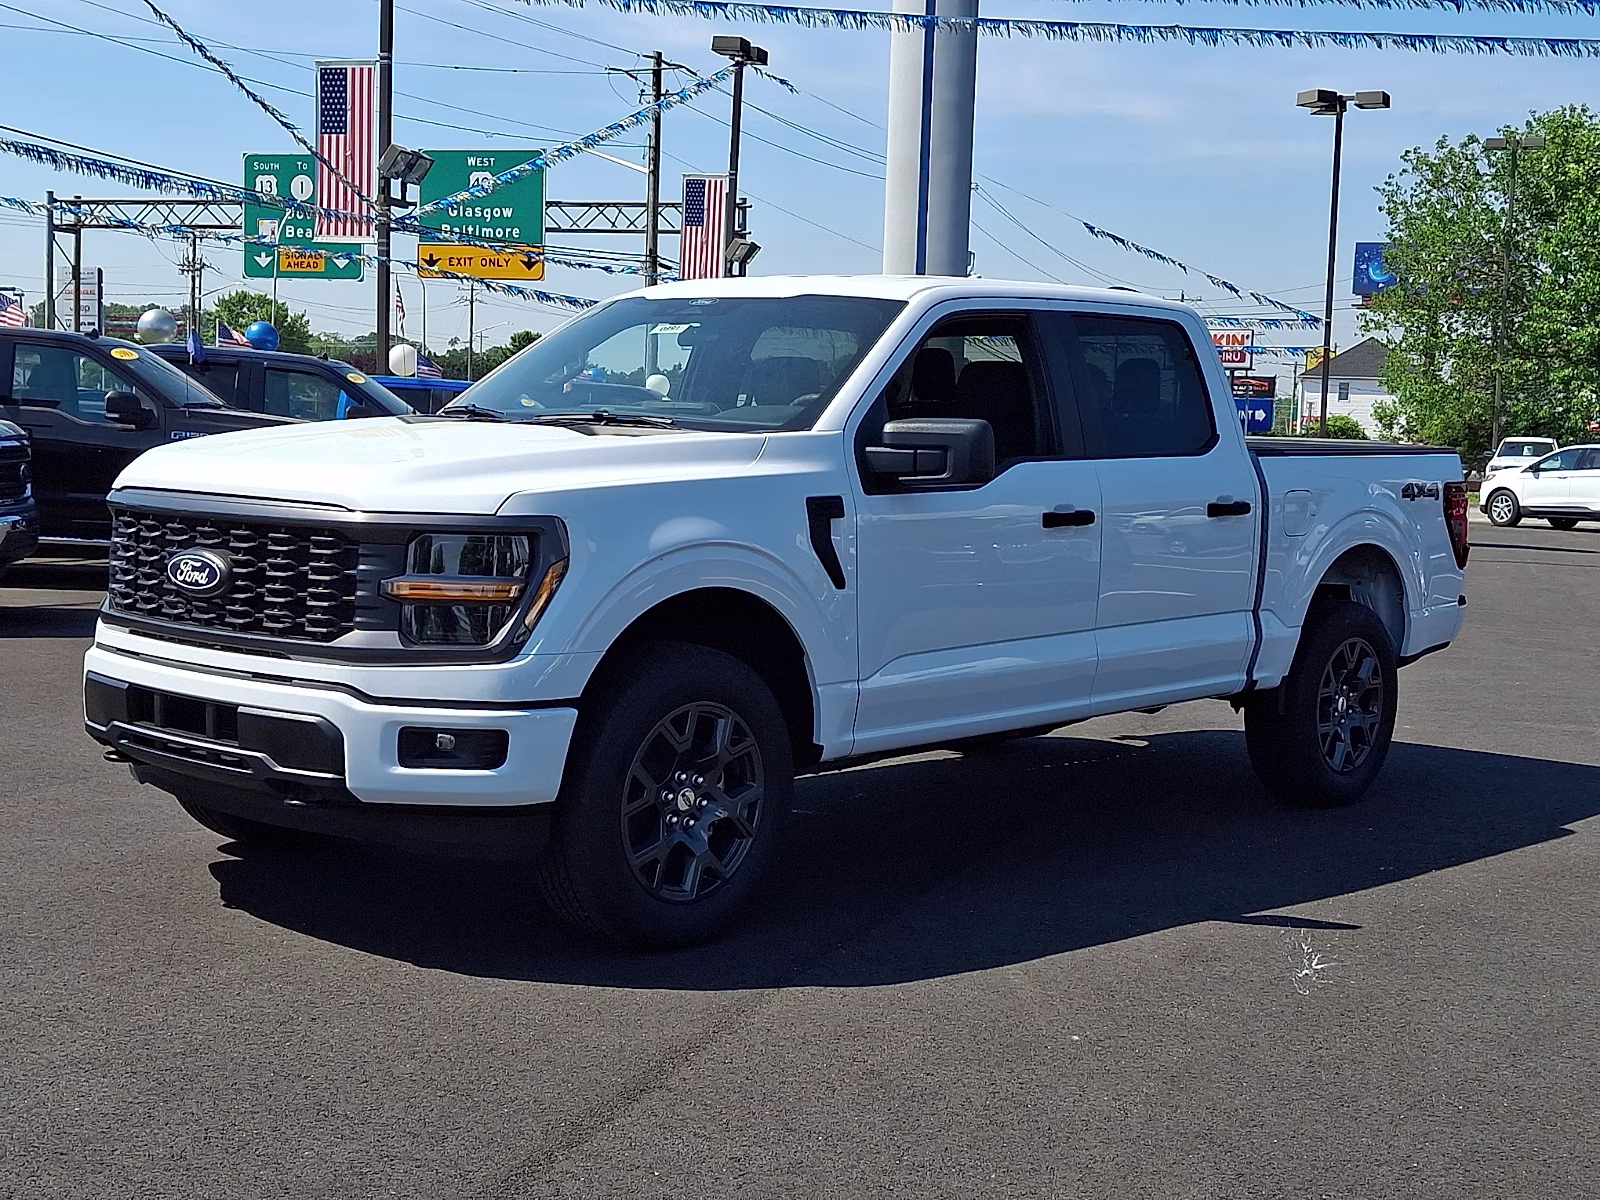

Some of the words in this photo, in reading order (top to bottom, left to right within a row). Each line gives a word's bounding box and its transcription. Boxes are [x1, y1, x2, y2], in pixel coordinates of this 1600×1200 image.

[253, 161, 280, 171] SOUTH
[296, 162, 308, 170] TO
[467, 156, 496, 167] WEST
[259, 180, 273, 193] 13
[299, 181, 305, 195] 1
[448, 205, 513, 222] Glasgow
[286, 260, 319, 269] AHEAD
[448, 257, 473, 267] EXIT
[480, 258, 511, 267] ONLY
[176, 559, 210, 585] Ford
